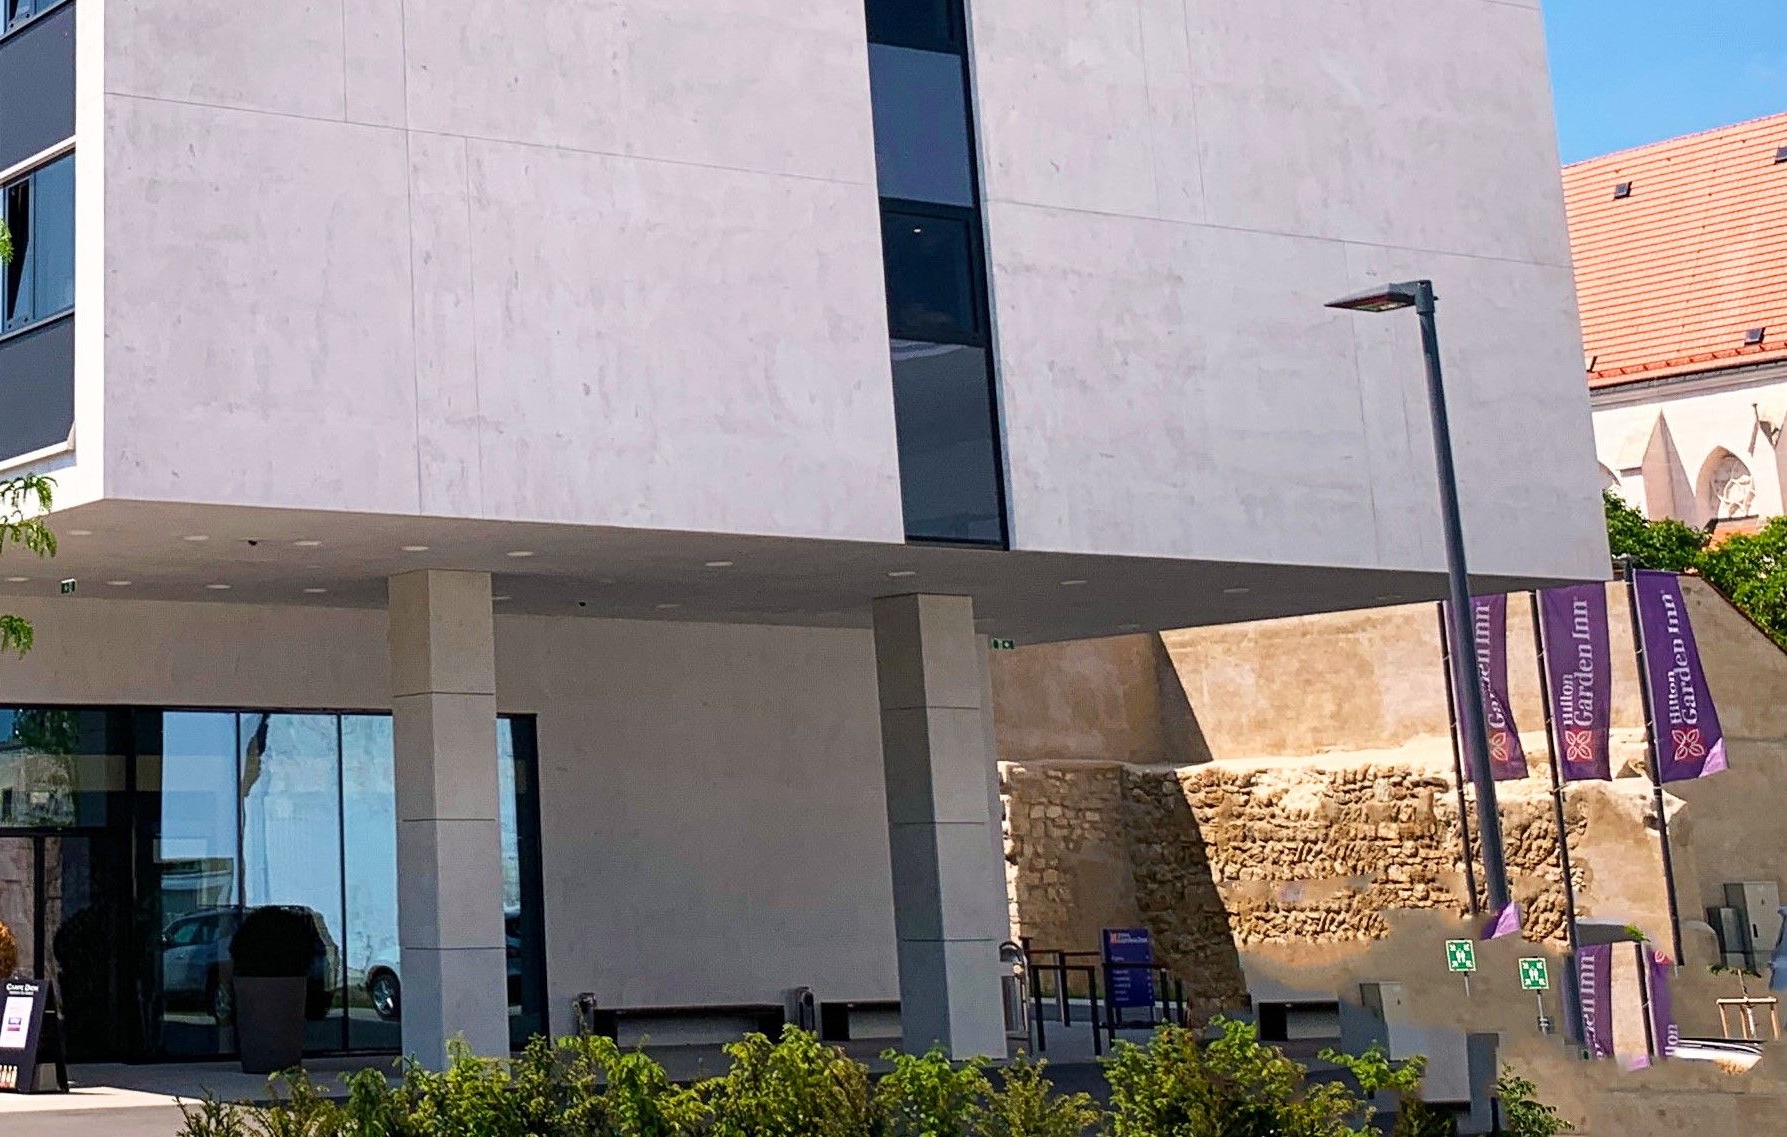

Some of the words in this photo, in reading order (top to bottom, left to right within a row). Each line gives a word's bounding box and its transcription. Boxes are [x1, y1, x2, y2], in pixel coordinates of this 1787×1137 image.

[1572, 600, 1590, 640] Inn
[1661, 594, 1680, 634] Inn
[1559, 674, 1574, 726] Hilton
[1572, 644, 1594, 726] Garden
[1667, 671, 1683, 724] Hilton
[1672, 638, 1698, 725] Garden
